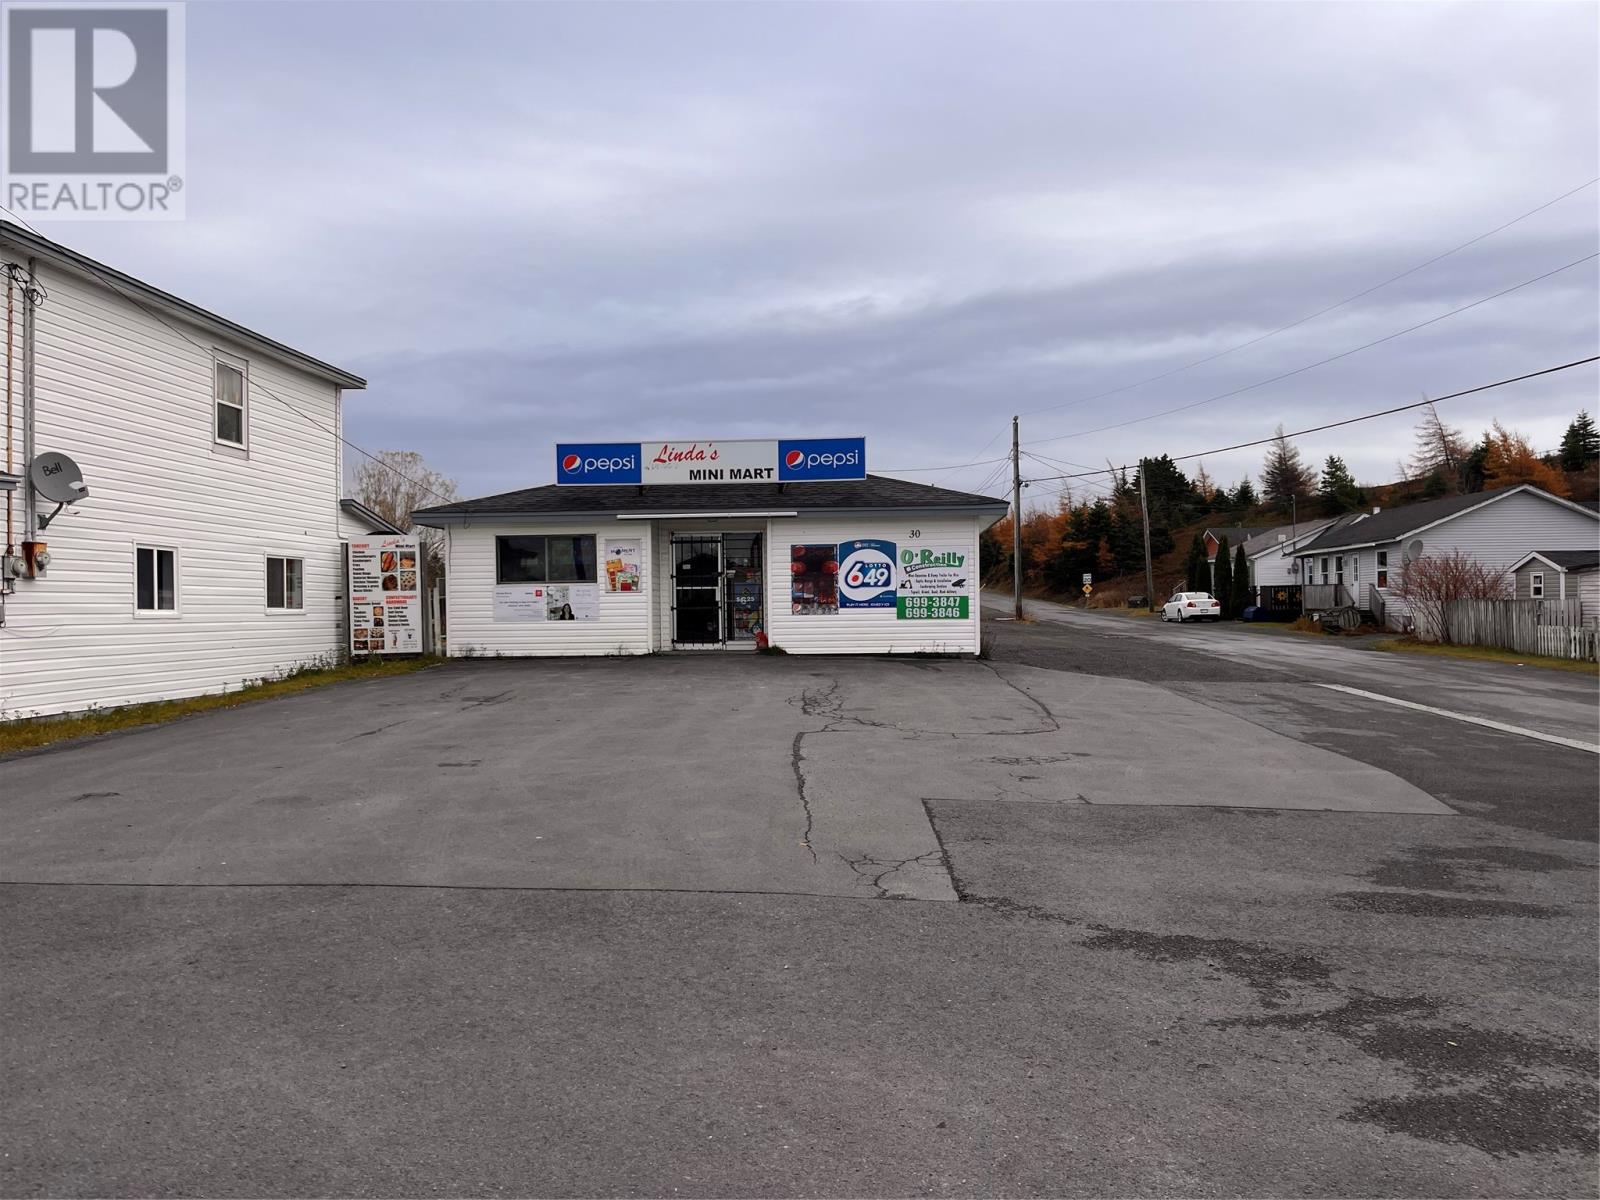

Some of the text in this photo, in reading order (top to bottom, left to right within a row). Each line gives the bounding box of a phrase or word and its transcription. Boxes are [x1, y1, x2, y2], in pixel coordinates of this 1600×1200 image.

[653, 443, 720, 464] Linda's
[807, 449, 859, 469] pepsi
[42, 462, 63, 477] Bell
[584, 454, 635, 473] pepsi
[689, 466, 774, 481] MINI MART
[908, 529, 921, 539] 30
[900, 549, 965, 568] O'Reilly
[905, 597, 960, 607] 699-3847
[905, 608, 960, 618] 699-3846
